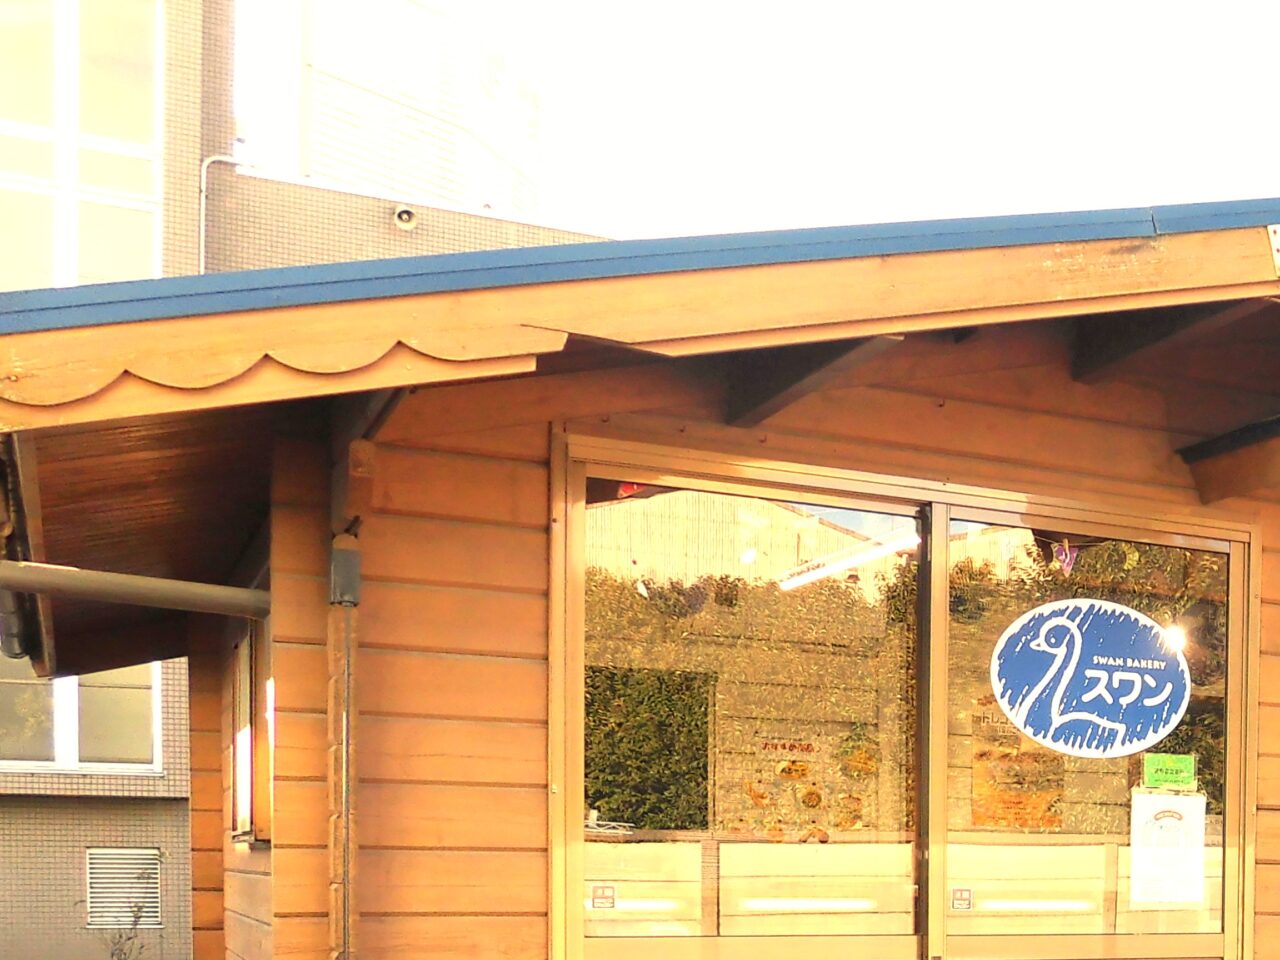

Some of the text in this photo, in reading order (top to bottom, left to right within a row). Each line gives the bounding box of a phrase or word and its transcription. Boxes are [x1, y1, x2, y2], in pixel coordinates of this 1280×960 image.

[1093, 655, 1167, 670] SWAN BAKERY
[1081, 669, 1173, 707] スワン
